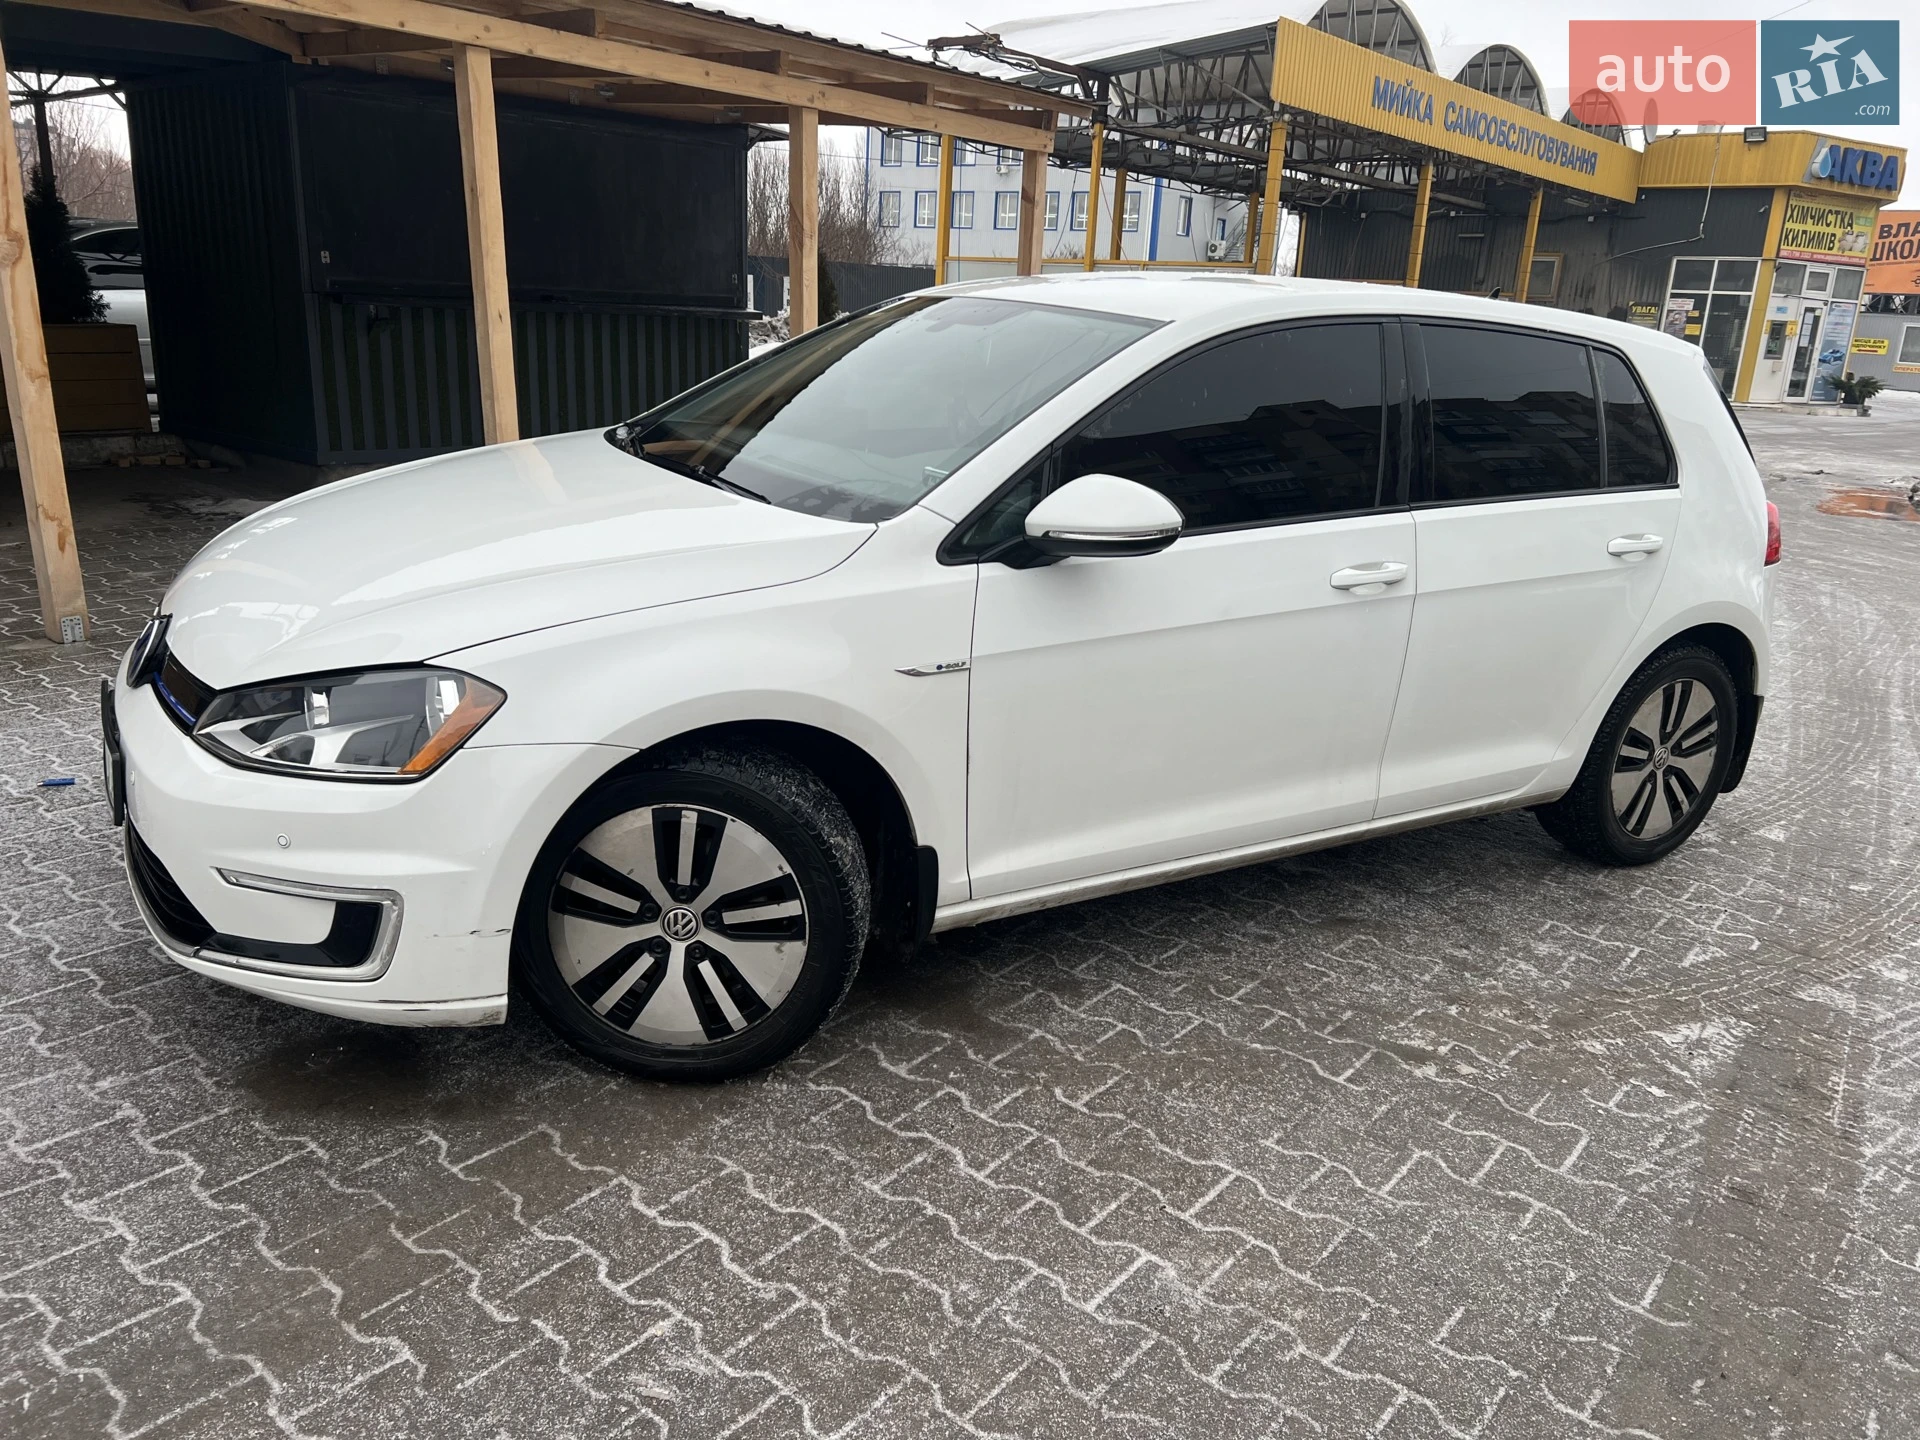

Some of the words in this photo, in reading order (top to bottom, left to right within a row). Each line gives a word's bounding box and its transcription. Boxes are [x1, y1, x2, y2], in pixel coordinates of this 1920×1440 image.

[1372, 75, 1434, 125] МИЙКА
[1443, 100, 1598, 176] САМООБСЛУГОВУВАННЯ
[1827, 144, 1898, 191] АКВА
[1787, 203, 1854, 230] ХІМЧИСТКА
[1783, 227, 1837, 251] КИЛИМІВ
[1631, 305, 1659, 314] УВАГА!
